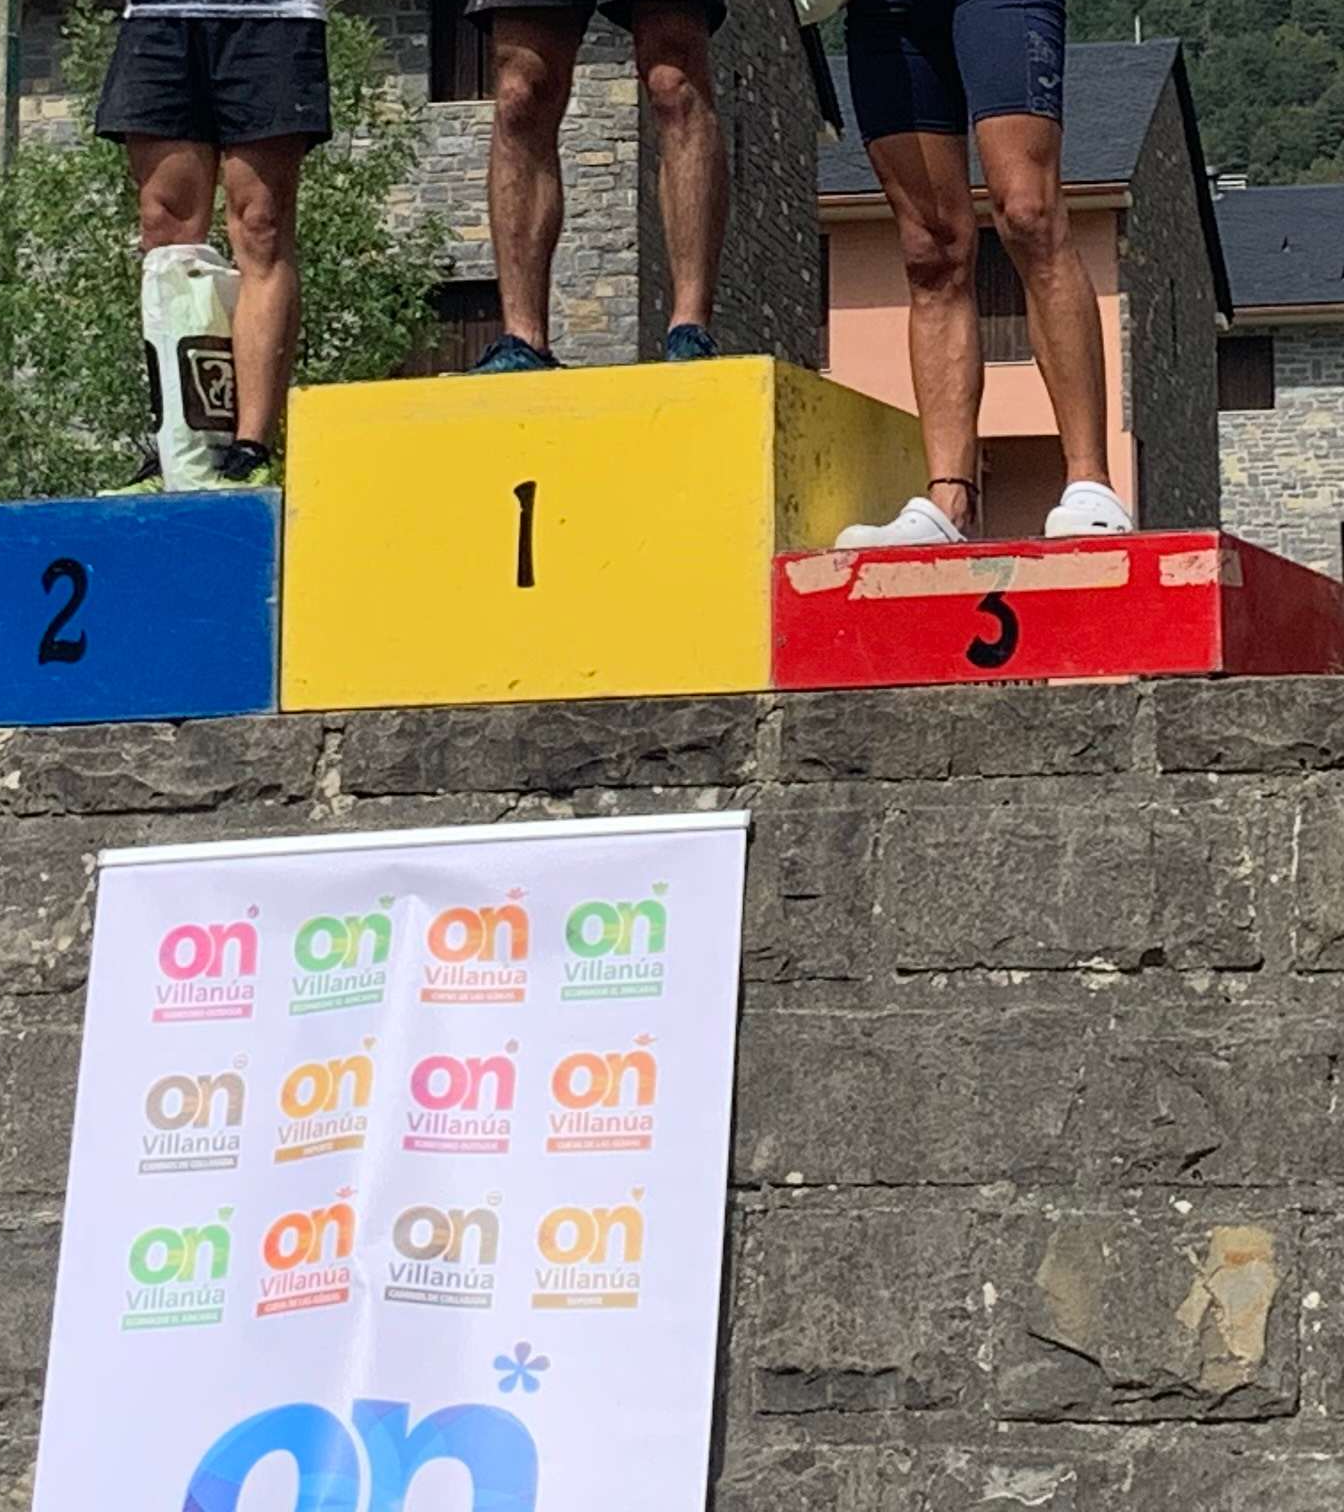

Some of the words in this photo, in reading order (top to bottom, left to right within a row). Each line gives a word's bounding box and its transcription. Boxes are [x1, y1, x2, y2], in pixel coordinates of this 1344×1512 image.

[513, 480, 537, 588] 1
[39, 557, 88, 665] 2
[965, 556, 1020, 669] 3
[159, 922, 258, 980] on
[294, 913, 393, 973] on
[427, 904, 529, 963] on
[565, 899, 667, 958] on
[156, 980, 254, 1004] Villanúa
[292, 968, 387, 997] Villanúa
[423, 963, 528, 986] Villanúa
[563, 958, 664, 982] Villanúa
[145, 1071, 246, 1131] on
[280, 1054, 373, 1119] on
[410, 1055, 516, 1111] on
[551, 1050, 656, 1109] on
[142, 1131, 240, 1156] Villanúa
[277, 1113, 368, 1145] Villanúa
[406, 1112, 511, 1135] Villanúa
[549, 1111, 653, 1134] Villanúa
[129, 1224, 231, 1285] on
[263, 1202, 354, 1270] on
[392, 1205, 499, 1265] on
[537, 1204, 644, 1265] on
[126, 1285, 225, 1311] Villanúa
[259, 1265, 350, 1298] Villanúa
[388, 1262, 495, 1290] Villanúa
[535, 1268, 641, 1290] Villanúa
[182, 1398, 539, 1512] on
